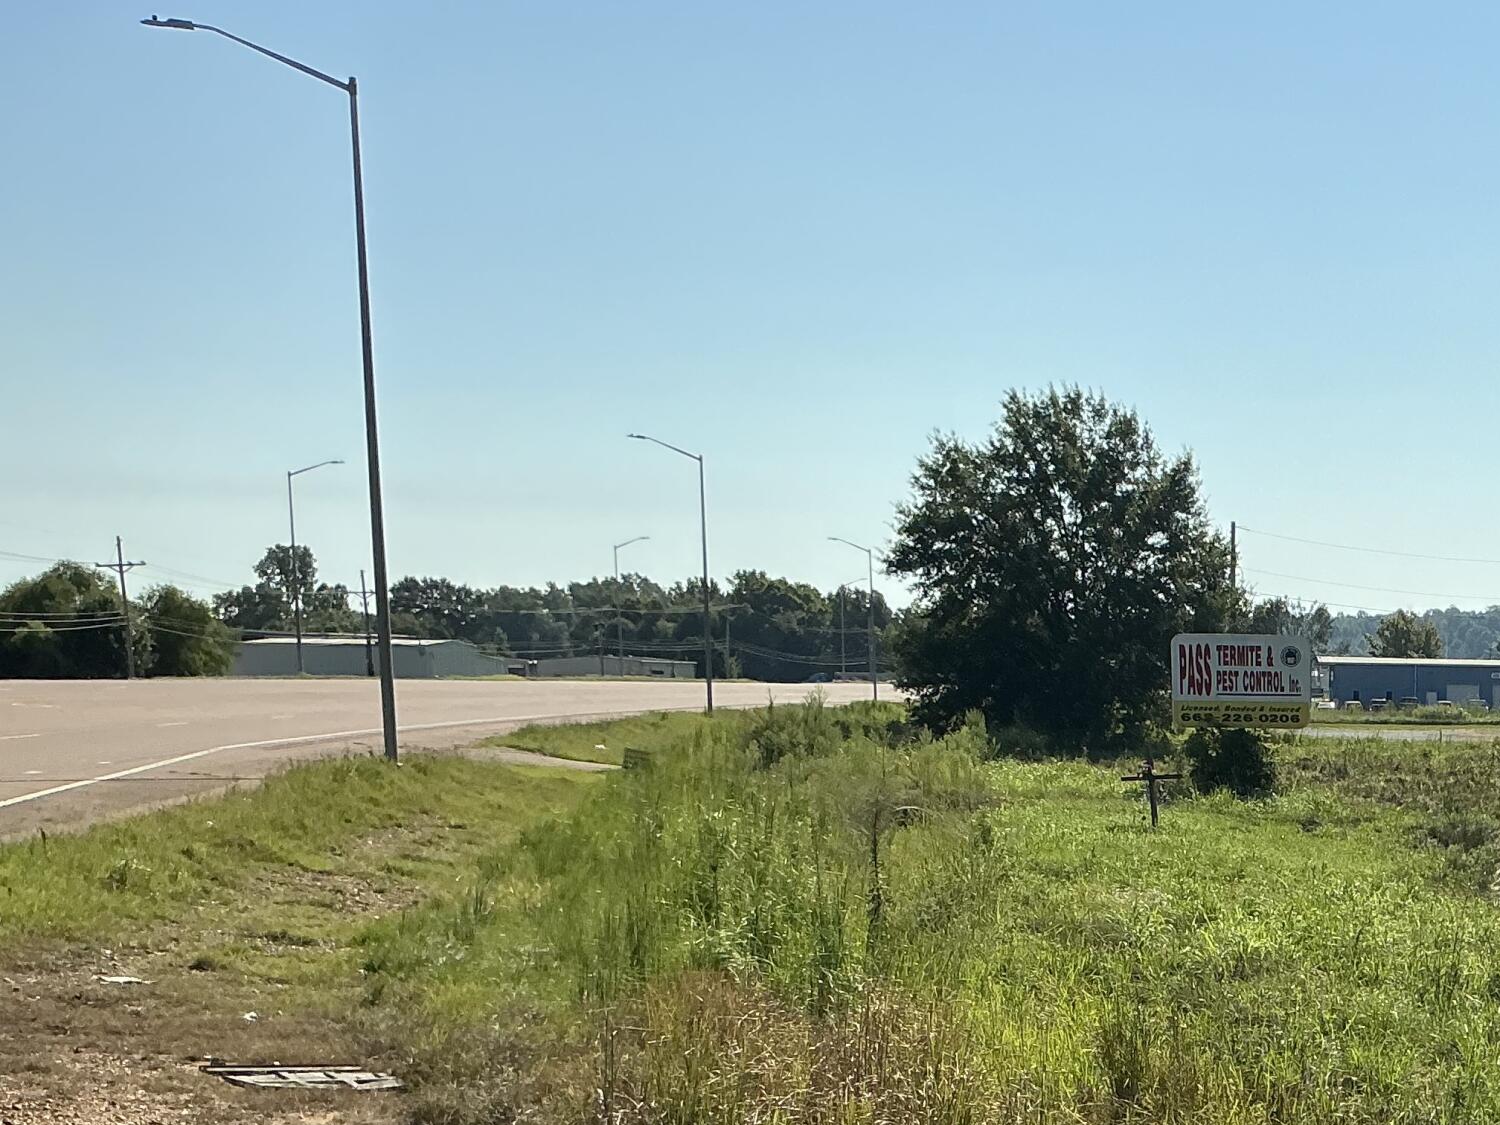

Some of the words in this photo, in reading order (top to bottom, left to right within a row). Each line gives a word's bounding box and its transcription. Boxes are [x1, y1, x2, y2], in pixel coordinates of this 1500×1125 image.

[1216, 645, 1262, 666] TERMITE
[1267, 646, 1273, 667] &
[1179, 643, 1212, 696] PASS
[1216, 671, 1239, 691] PEST
[1243, 671, 1284, 692] CONTROL
